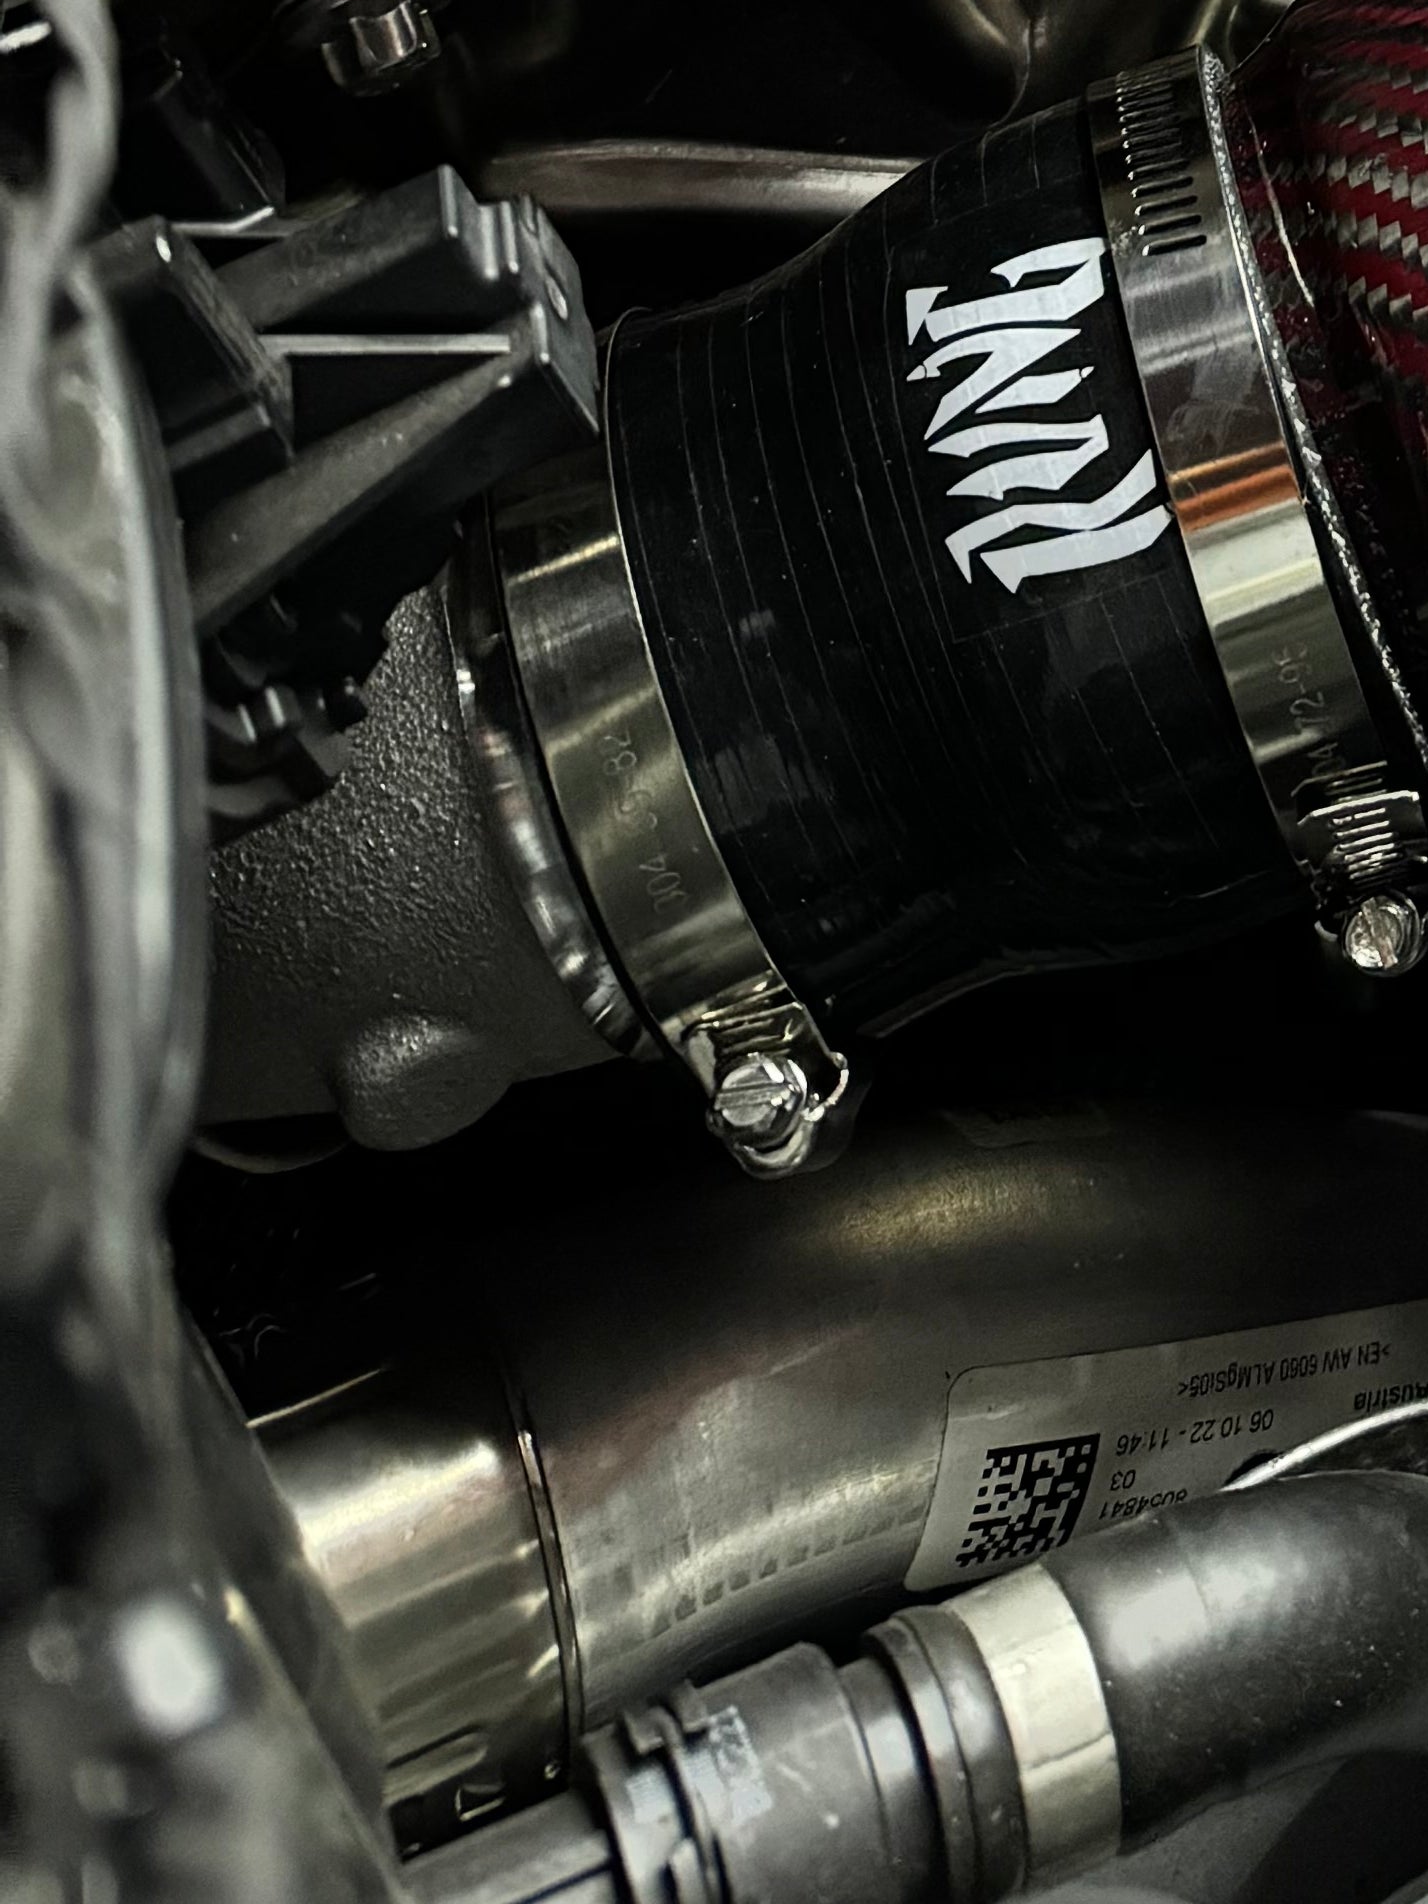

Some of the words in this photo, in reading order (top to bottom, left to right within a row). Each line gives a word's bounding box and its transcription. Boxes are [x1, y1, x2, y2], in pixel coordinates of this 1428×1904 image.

[1322, 1347, 1351, 1373] AW
[1190, 1418, 1215, 1443] 22
[1249, 1408, 1275, 1433] 06
[1115, 1426, 1170, 1457] 11:46
[1110, 1468, 1137, 1492] 03
